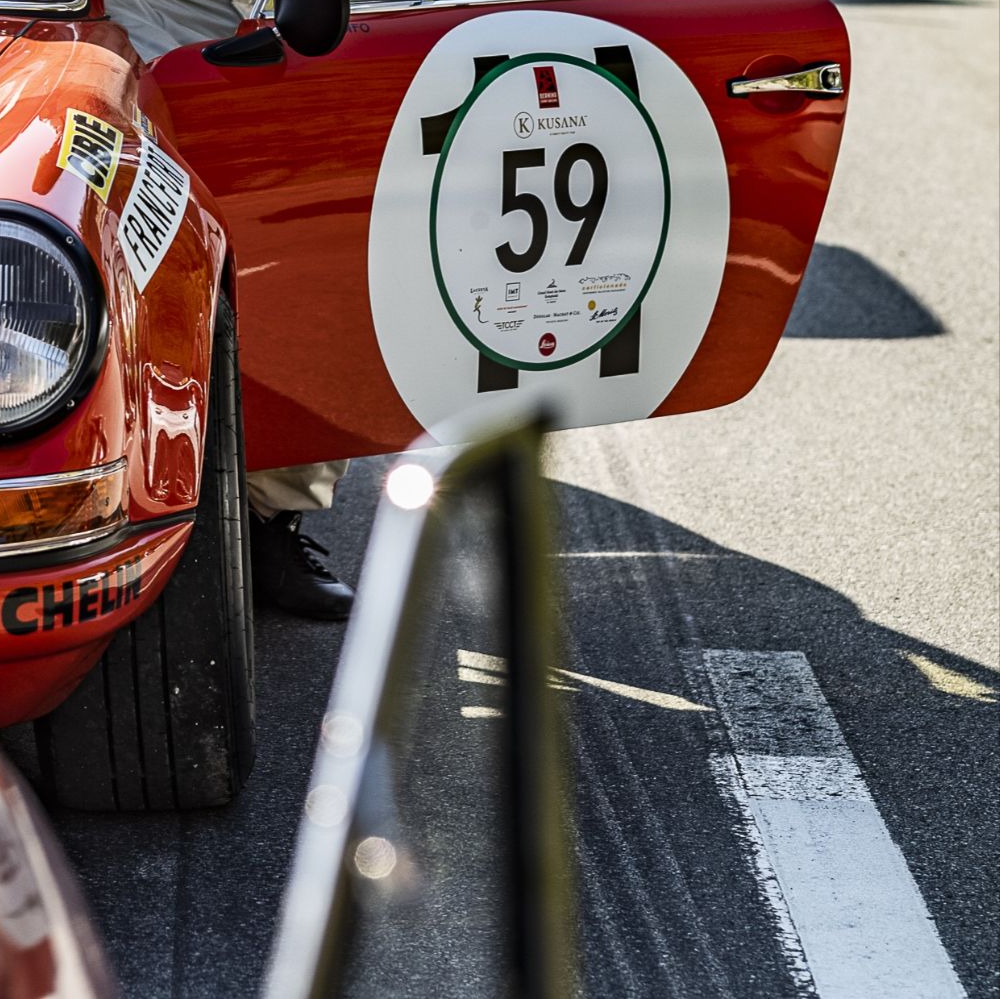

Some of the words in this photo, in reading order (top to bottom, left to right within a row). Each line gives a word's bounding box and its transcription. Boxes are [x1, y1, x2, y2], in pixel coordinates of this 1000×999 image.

[537, 115, 587, 130] KUSANA
[123, 145, 186, 273] FRANCFORT
[495, 142, 609, 273] 59
